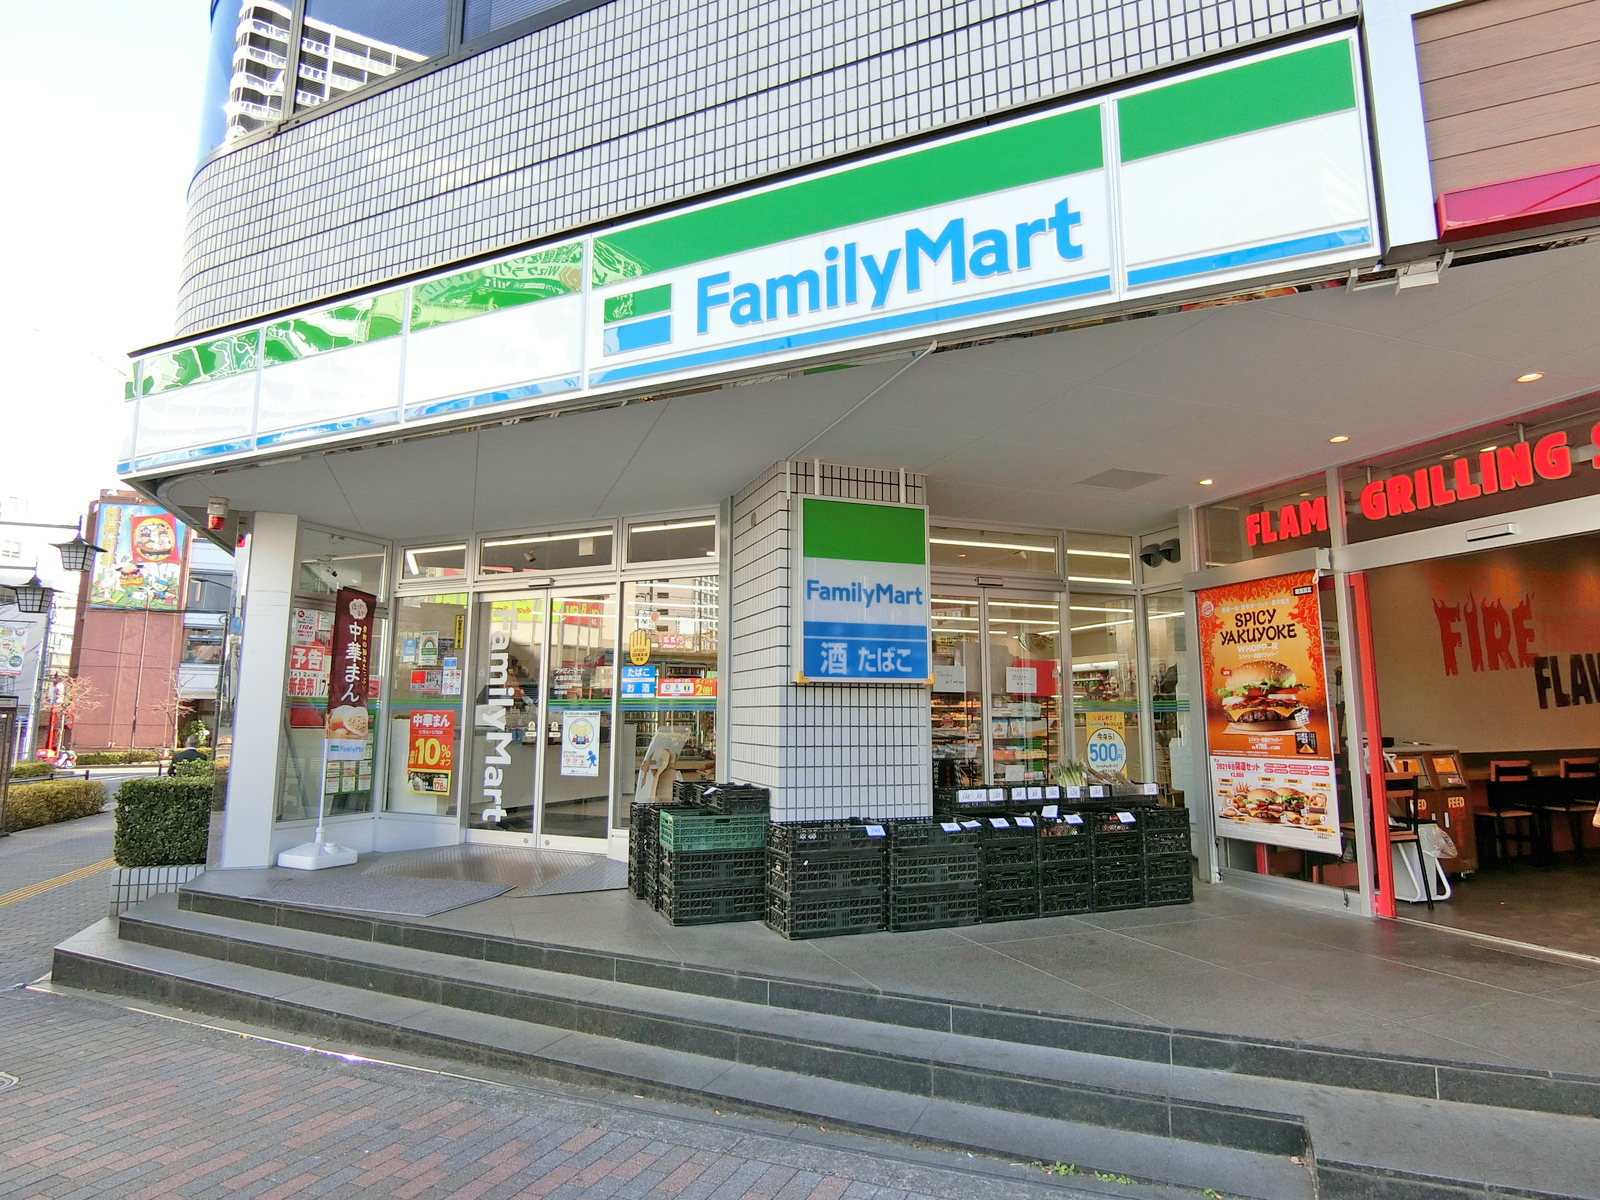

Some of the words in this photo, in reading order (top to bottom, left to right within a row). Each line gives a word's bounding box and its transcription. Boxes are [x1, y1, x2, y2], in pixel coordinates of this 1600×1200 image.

[697, 196, 1085, 336] FamilyMart
[1246, 496, 1328, 546] FLAM
[1360, 431, 1571, 520] GRILLING
[807, 580, 923, 608] FamilyMart
[1235, 608, 1277, 628] SPICY
[1220, 623, 1297, 646] YAKUYOKE
[1432, 587, 1539, 677] FIRE
[292, 647, 323, 670] 予告
[341, 621, 362, 703] 中華まん
[820, 641, 848, 675] 酒
[858, 646, 913, 673] たばこ
[627, 667, 650, 677] たばこ
[413, 713, 450, 728] 中華まん
[482, 610, 518, 822] FamilyMart
[1097, 732, 1115, 740] 今なら!
[1089, 743, 1117, 762] 500
[1447, 796, 1465, 809] FEED
